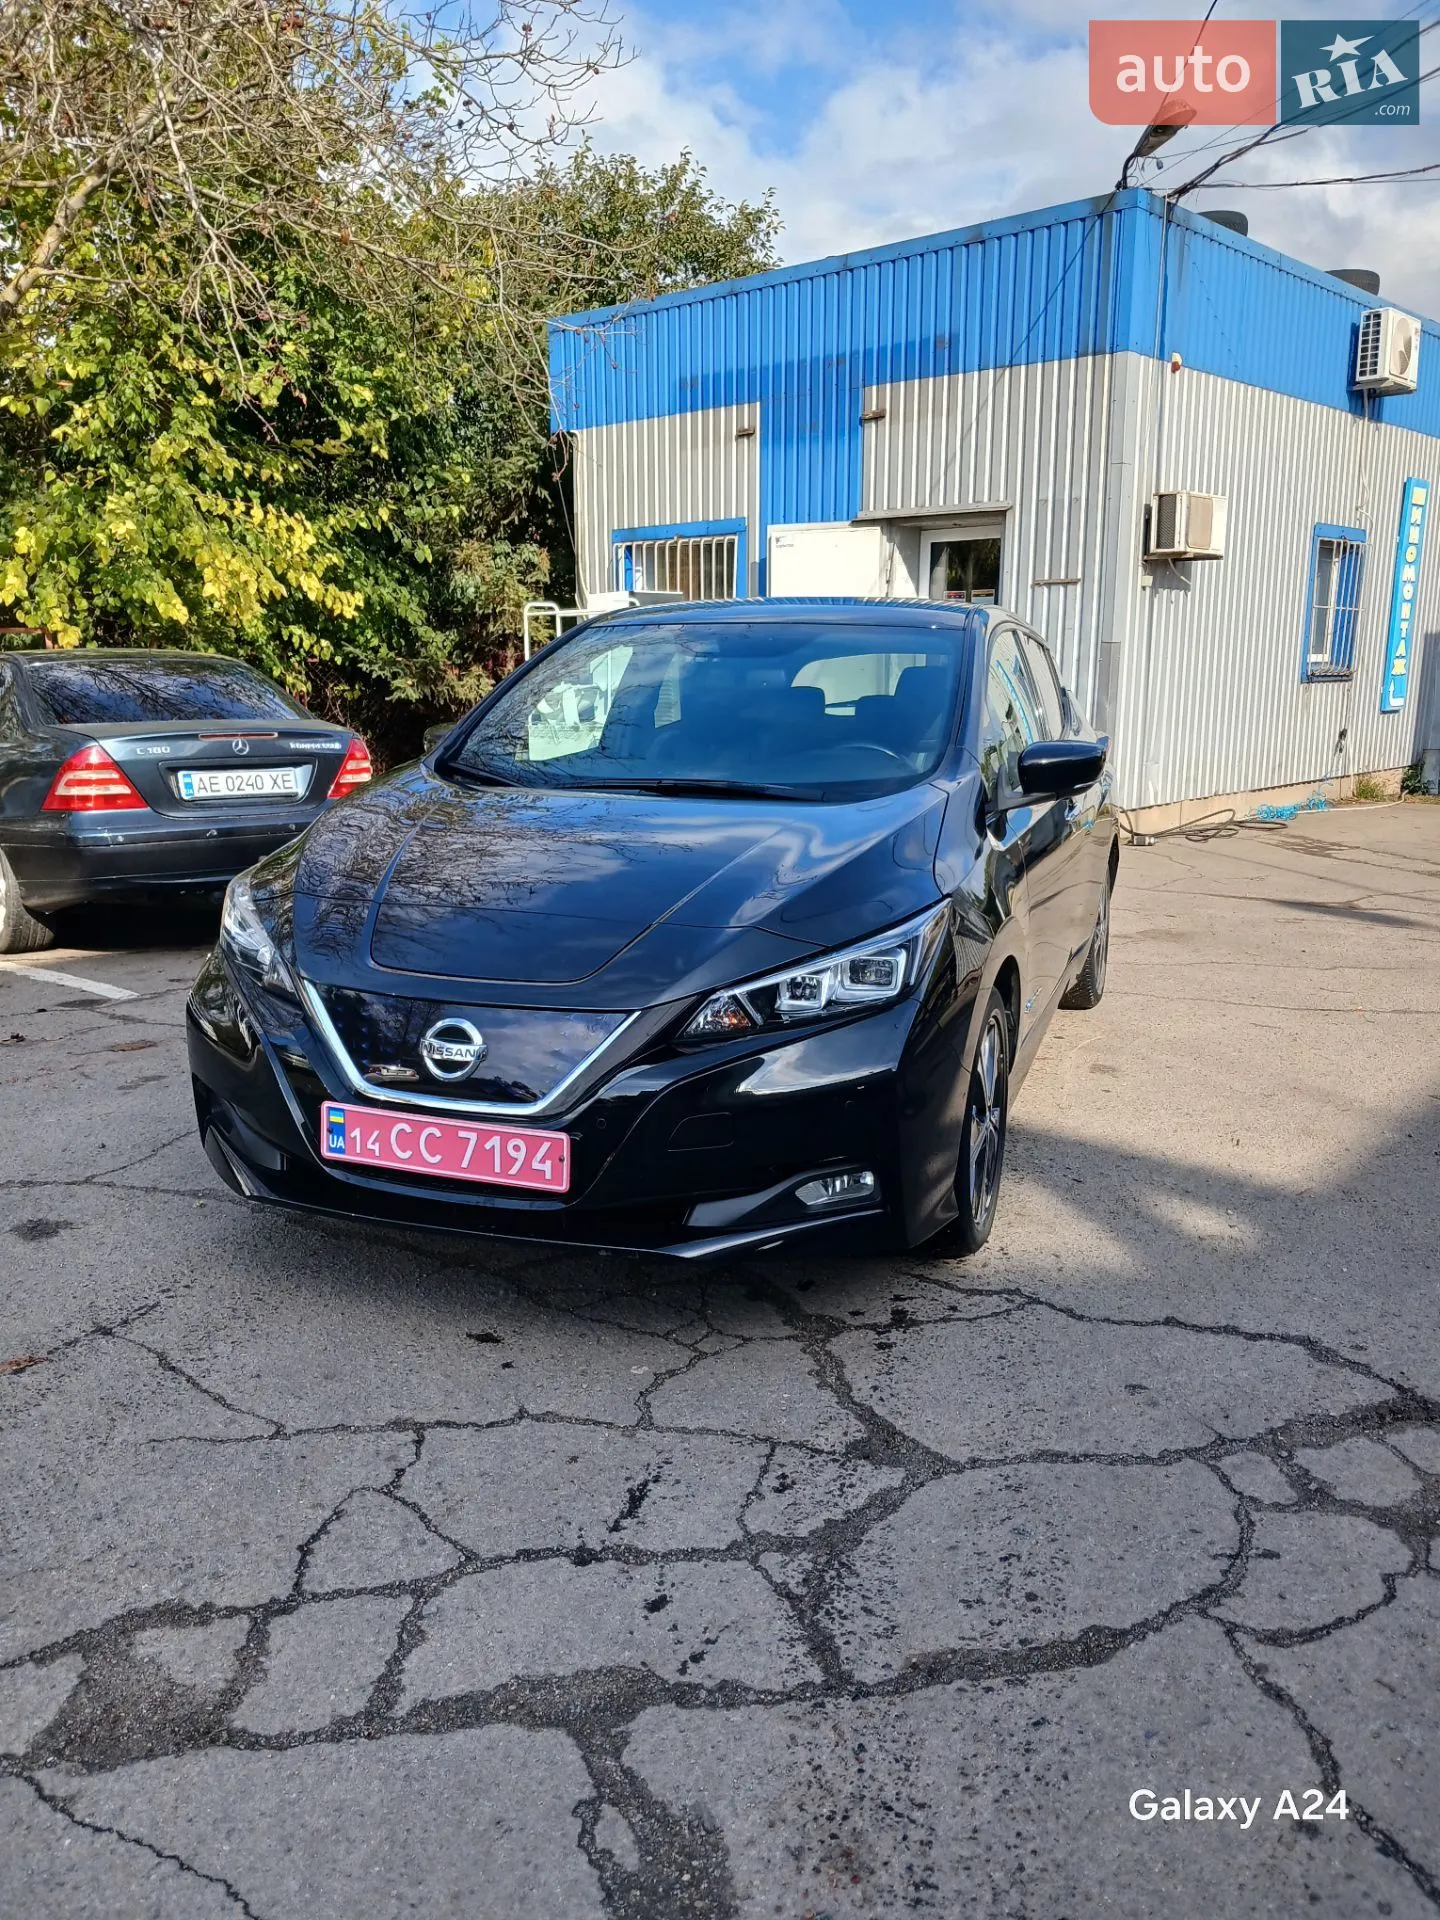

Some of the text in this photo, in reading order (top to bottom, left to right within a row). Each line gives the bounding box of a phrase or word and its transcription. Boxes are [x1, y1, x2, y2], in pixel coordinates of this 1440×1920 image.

[197, 775, 220, 793] AE
[225, 774, 264, 792] 0240
[269, 773, 293, 790] XE
[422, 1042, 476, 1058] NISSAN
[329, 1134, 345, 1149] UA
[457, 1131, 552, 1180] 7194
